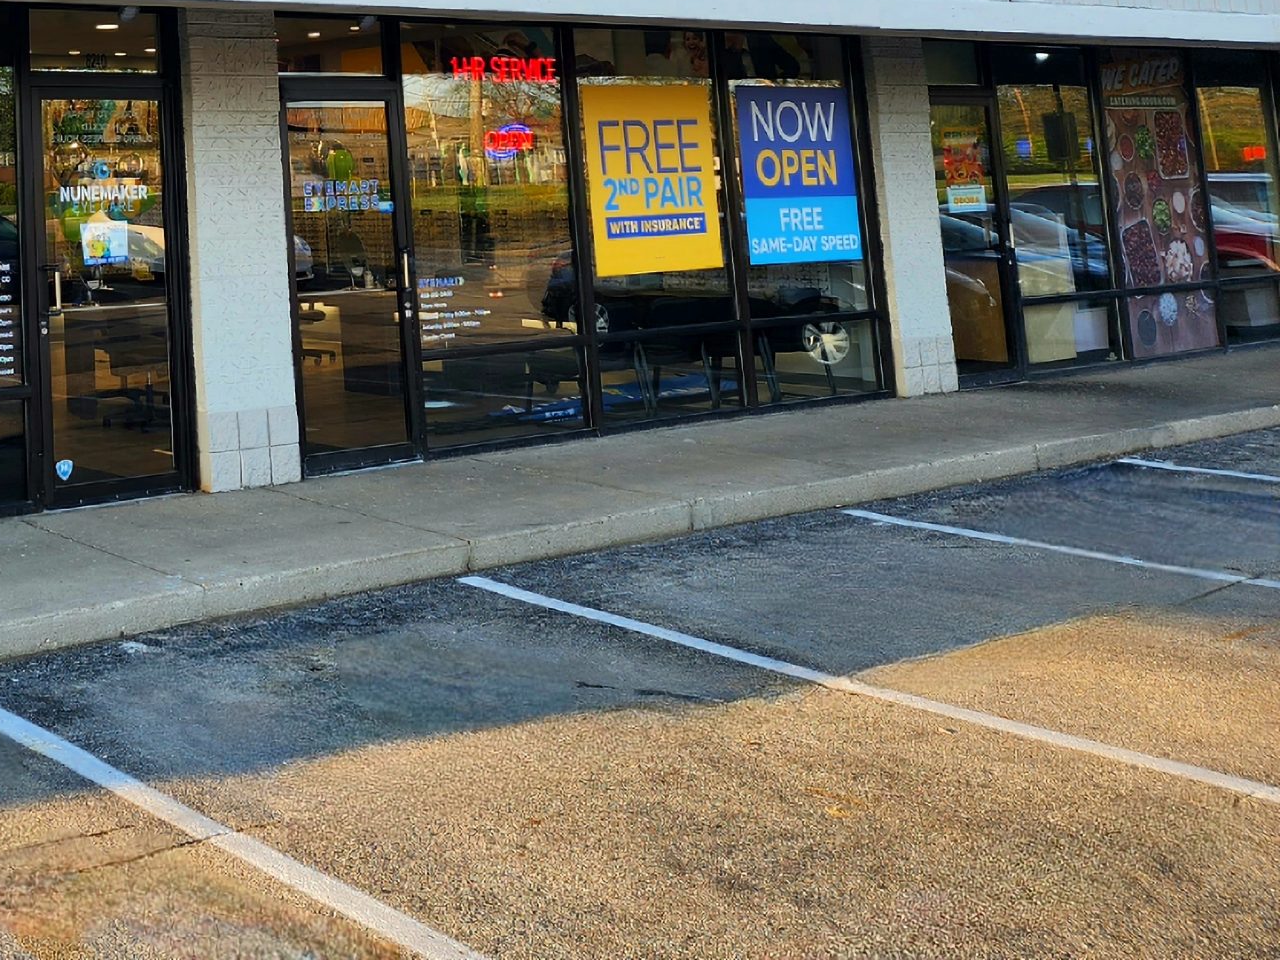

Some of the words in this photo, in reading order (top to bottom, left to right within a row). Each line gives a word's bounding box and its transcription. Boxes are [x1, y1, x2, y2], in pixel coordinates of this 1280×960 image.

[491, 56, 556, 84] SERVICE
[1102, 65, 1126, 91] WE
[1129, 57, 1180, 88] CATER
[750, 100, 836, 143] NOW
[484, 130, 535, 151] OPEN
[597, 119, 702, 175] FREE
[755, 148, 838, 187] OPEN
[60, 184, 148, 202] NUNEMAKER
[604, 177, 640, 211] 2ND
[644, 176, 704, 209] PAIR
[72, 201, 96, 213] EYE
[100, 200, 135, 213] CARE
[779, 207, 825, 232] FREE
[610, 219, 638, 235] WITH
[751, 235, 817, 255] SAME-DAY
[820, 232, 860, 252] SPEED
